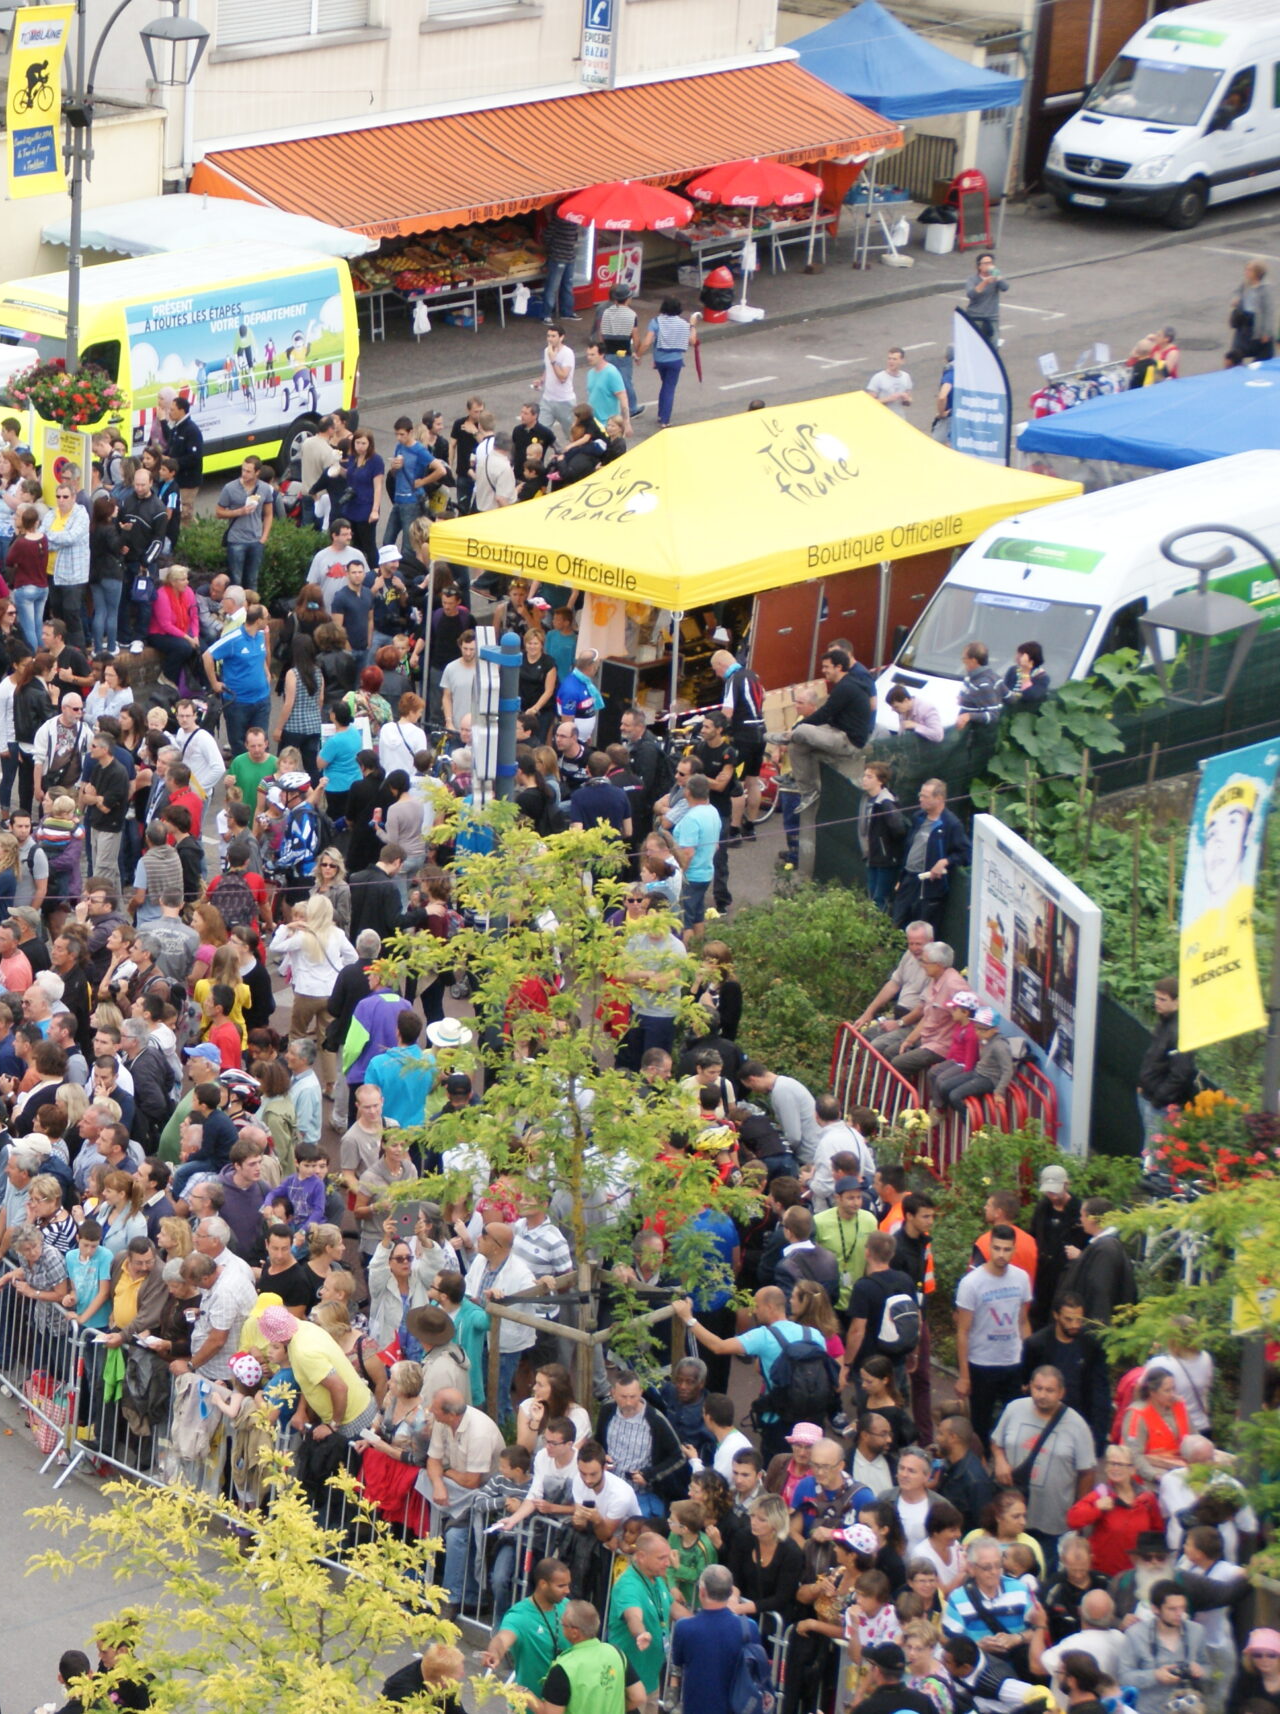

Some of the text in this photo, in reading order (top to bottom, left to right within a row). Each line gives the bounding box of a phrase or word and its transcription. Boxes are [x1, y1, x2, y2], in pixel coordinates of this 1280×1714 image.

[585, 45, 609, 58] BAZAR
[360, 222, 401, 236] TAXIPHONE
[152, 298, 195, 318] PRÉSENT
[154, 313, 188, 330] TOUTES
[190, 309, 207, 324] LES
[209, 302, 242, 320] ÉTAPES
[210, 302, 309, 333] VOTRE DÉPARTEMENT
[808, 514, 964, 568] Boutique Officielle
[466, 538, 638, 591] Boutique Officielle
[1202, 945, 1230, 962] Eddy
[1190, 958, 1242, 989] MERCKX
